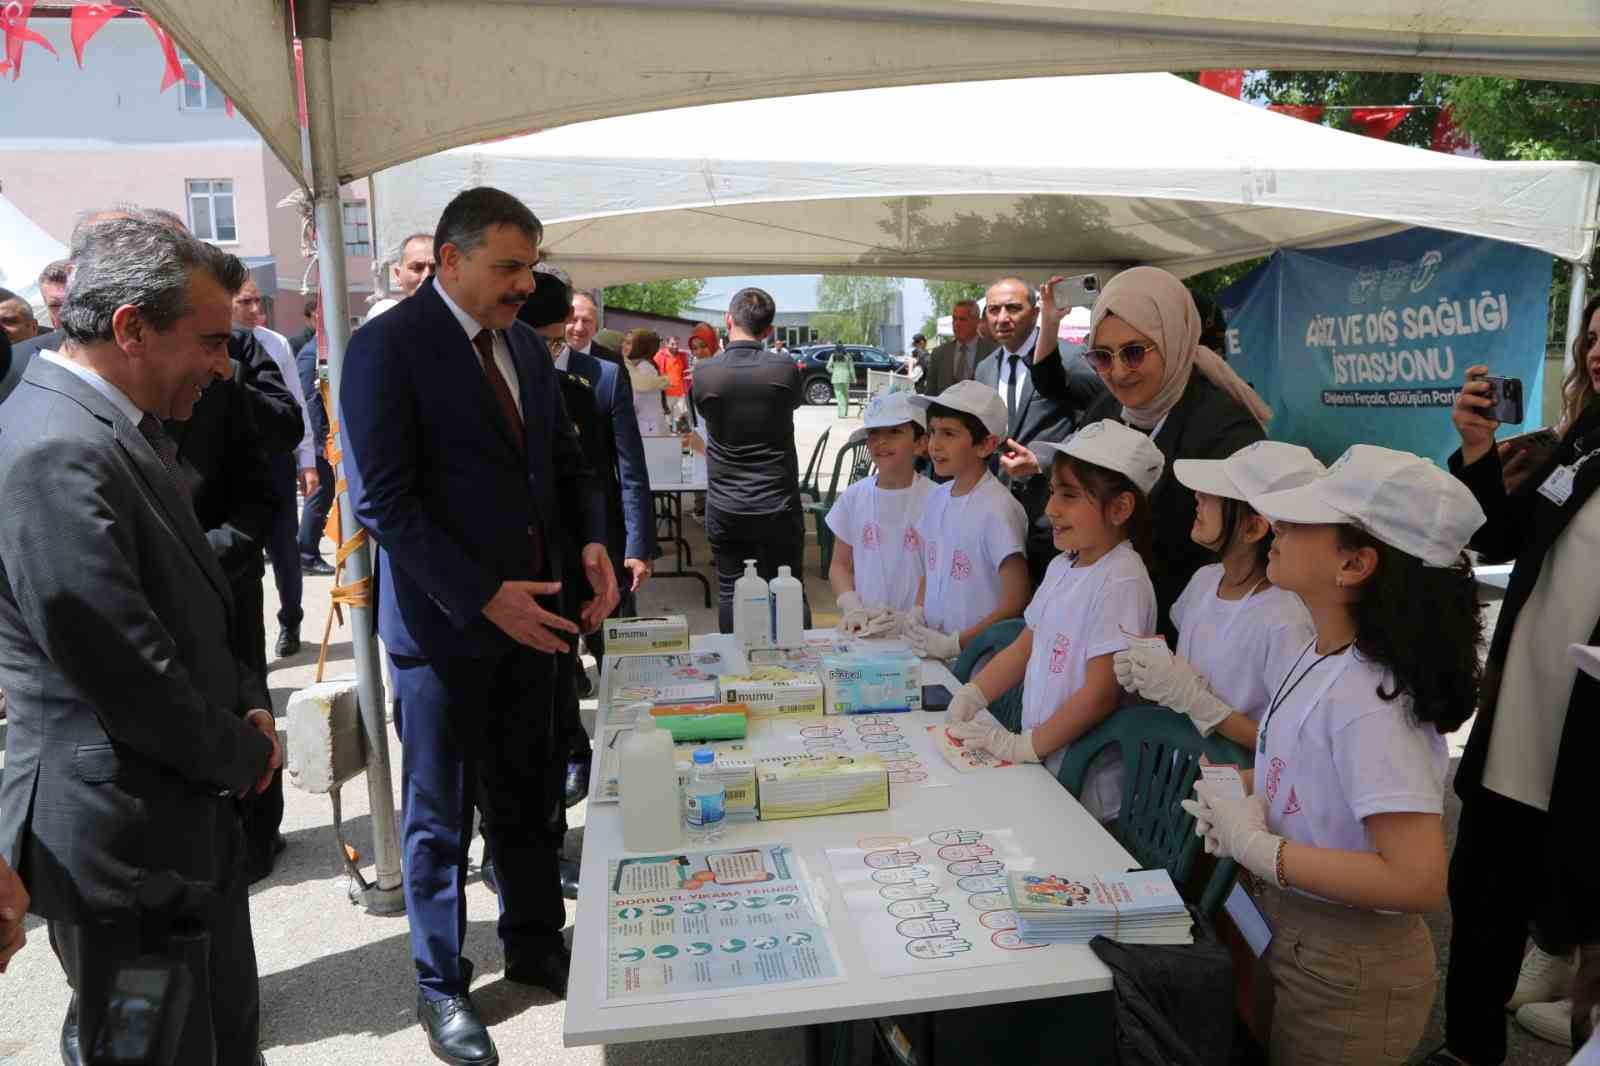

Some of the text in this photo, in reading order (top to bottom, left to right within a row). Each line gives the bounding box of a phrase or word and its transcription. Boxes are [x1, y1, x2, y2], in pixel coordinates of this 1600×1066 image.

[1339, 314, 1364, 346] VE
[1366, 308, 1399, 347] DİŞ
[1403, 290, 1509, 340] SAĞLIĞI
[1333, 347, 1455, 385] İSTASYONU
[1389, 391, 1431, 407] Gülüşün
[618, 629, 648, 639] mumu
[737, 693, 774, 702] mumu
[689, 890, 742, 901] YIKAMA
